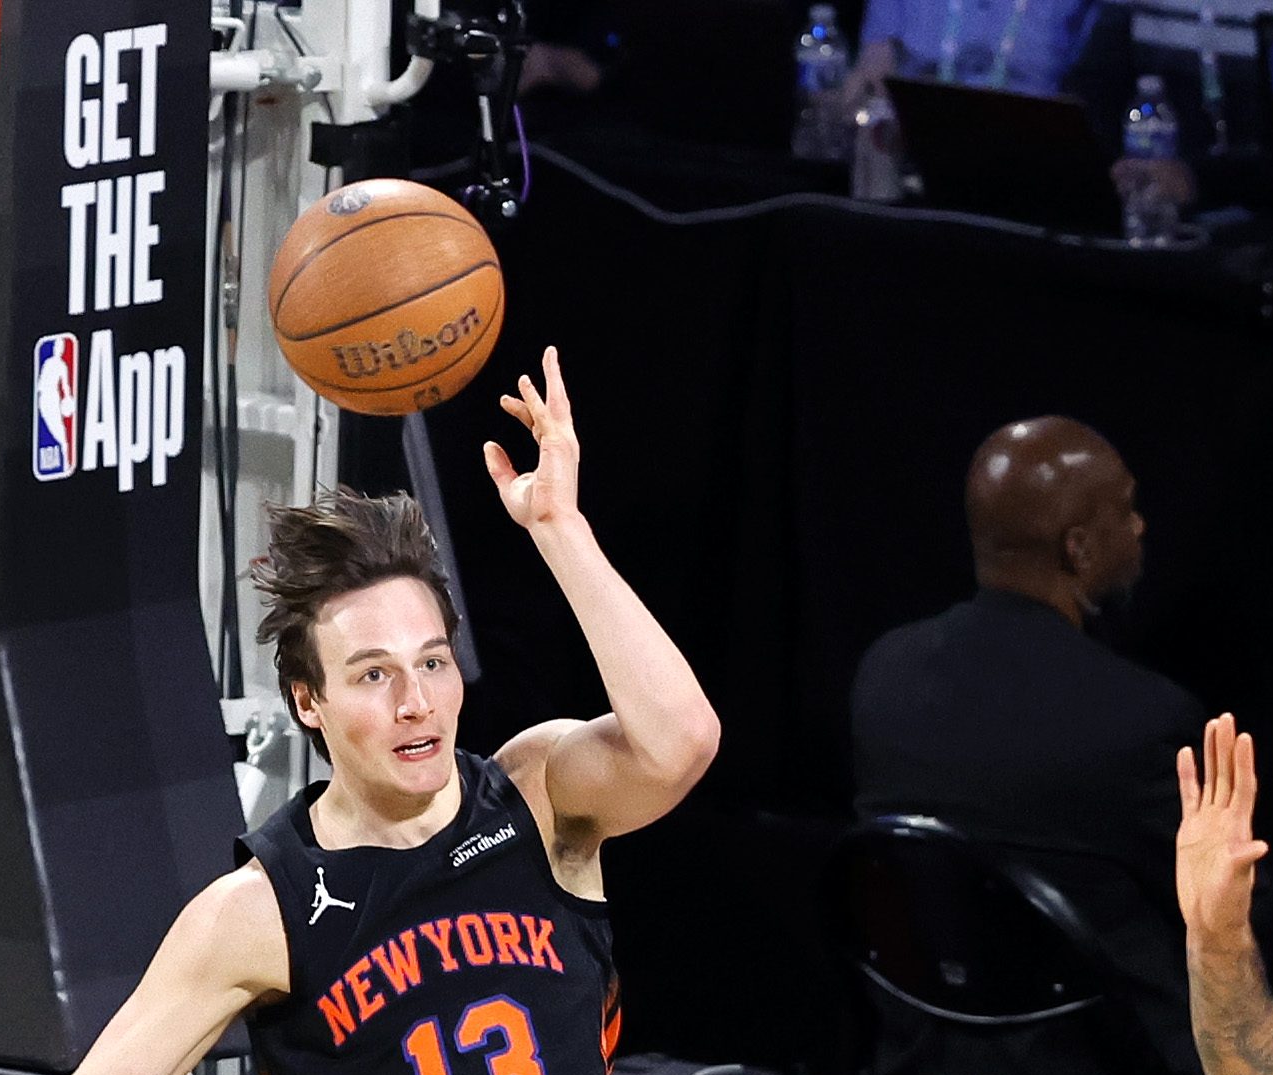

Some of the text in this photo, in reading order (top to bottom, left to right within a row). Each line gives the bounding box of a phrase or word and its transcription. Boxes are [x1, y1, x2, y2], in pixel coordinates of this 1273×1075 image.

[64, 23, 168, 169] GET
[61, 170, 166, 316] THE
[82, 329, 186, 493] App
[331, 307, 480, 378] Wilson
[452, 845, 479, 868] abu
[477, 823, 516, 851] dhabi
[317, 912, 565, 1047] NEW YORK
